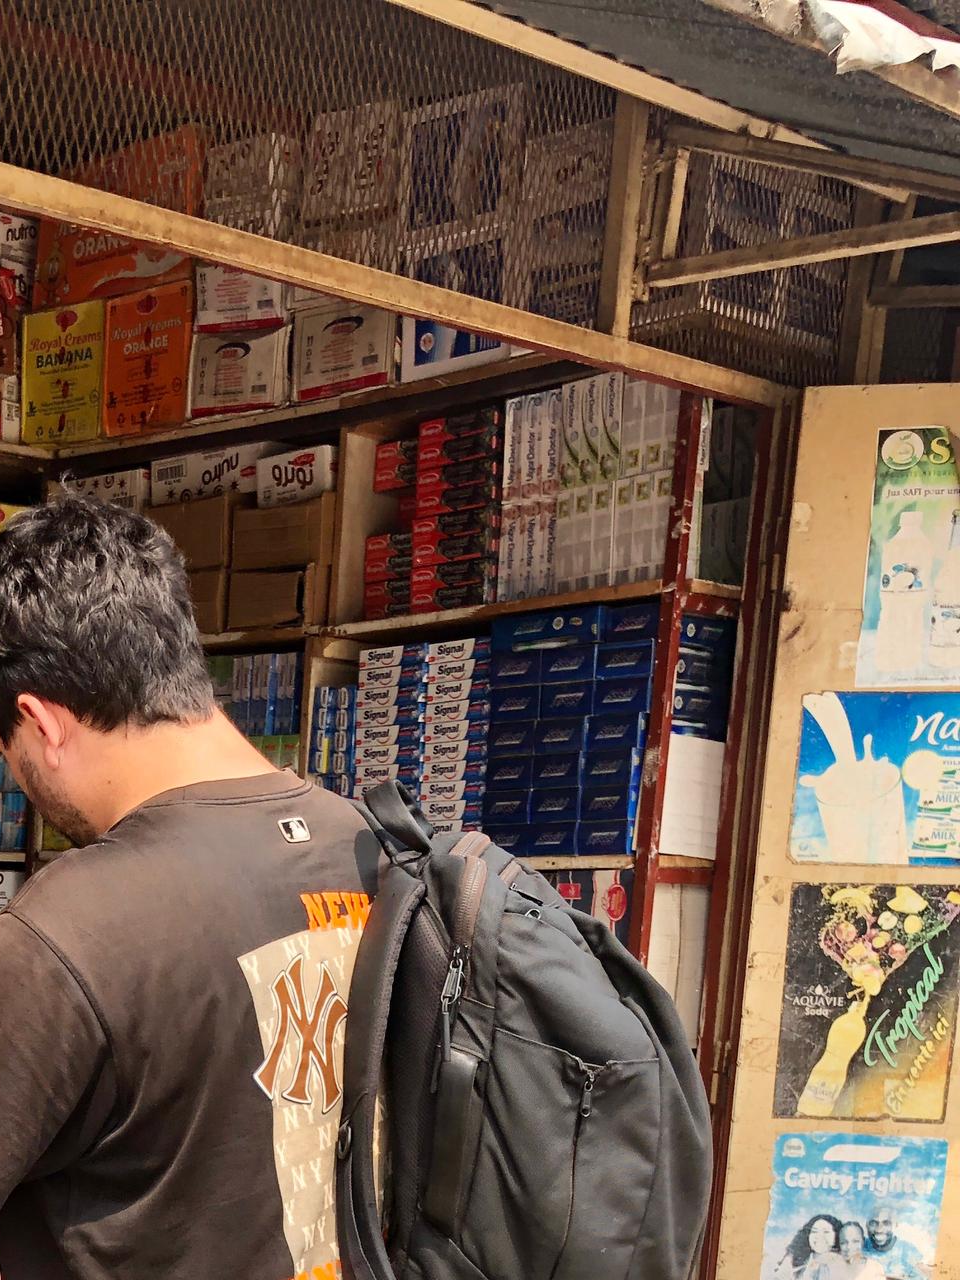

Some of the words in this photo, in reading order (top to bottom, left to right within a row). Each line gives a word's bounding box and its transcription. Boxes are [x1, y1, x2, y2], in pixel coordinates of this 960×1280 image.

[6, 225, 37, 242] nutro
[112, 323, 141, 341] Royal
[29, 334, 62, 352] Royal
[64, 331, 102, 348] Creams
[123, 335, 169, 354] ORANGE
[36, 347, 93, 369] BANANA
[201, 452, 239, 486] nutro
[886, 488, 902, 499] Jus
[367, 650, 394, 663] Signal
[437, 643, 465, 657] Signal
[366, 670, 392, 682] Signal
[437, 663, 465, 676] Signal
[364, 690, 390, 702] Signal
[435, 683, 462, 696] Signal
[434, 703, 460, 717] Signal
[364, 729, 390, 741] Signal
[433, 722, 460, 736] Signal
[432, 743, 459, 756] Signal
[431, 763, 457, 776] Signal
[429, 783, 456, 796] Signal
[429, 803, 456, 816] Signal
[930, 831, 956, 840] MILK
[300, 891, 373, 932] NEW
[792, 996, 844, 1008] AQUAVIE
[863, 943, 944, 1069] Tropical
[804, 1007, 830, 1018] Soda
[904, 1040, 936, 1089] vente
[930, 1012, 950, 1041] ici
[784, 1166, 853, 1196] Cavity
